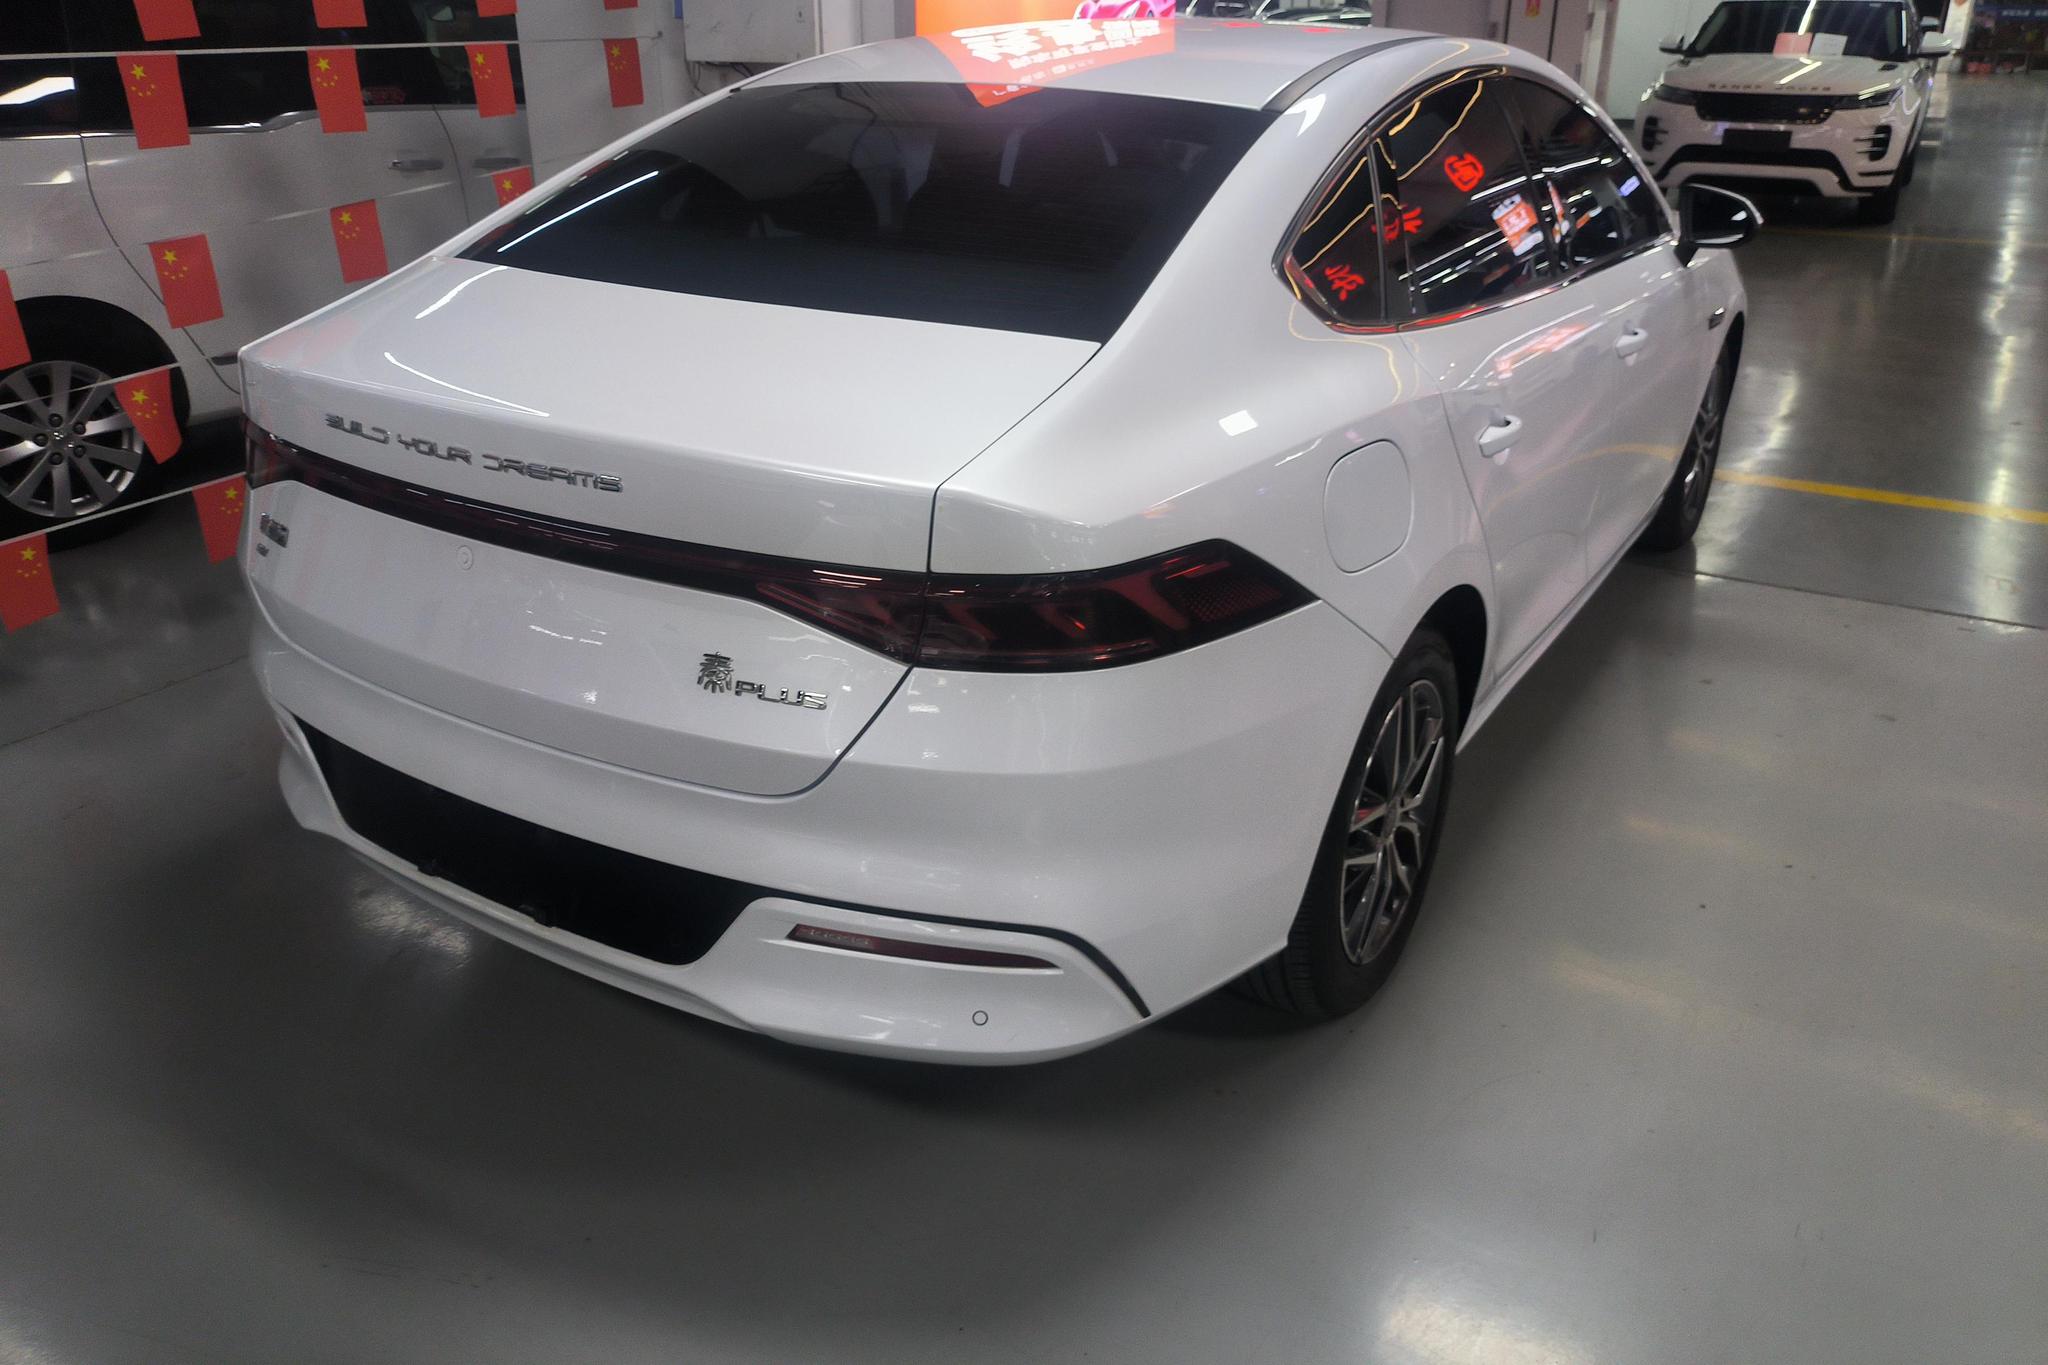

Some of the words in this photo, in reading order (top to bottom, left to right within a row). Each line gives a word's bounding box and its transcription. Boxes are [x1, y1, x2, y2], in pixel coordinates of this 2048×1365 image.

[397, 433, 472, 466] YOUR
[482, 453, 624, 493] DREAMS
[735, 680, 828, 710] PLUS
